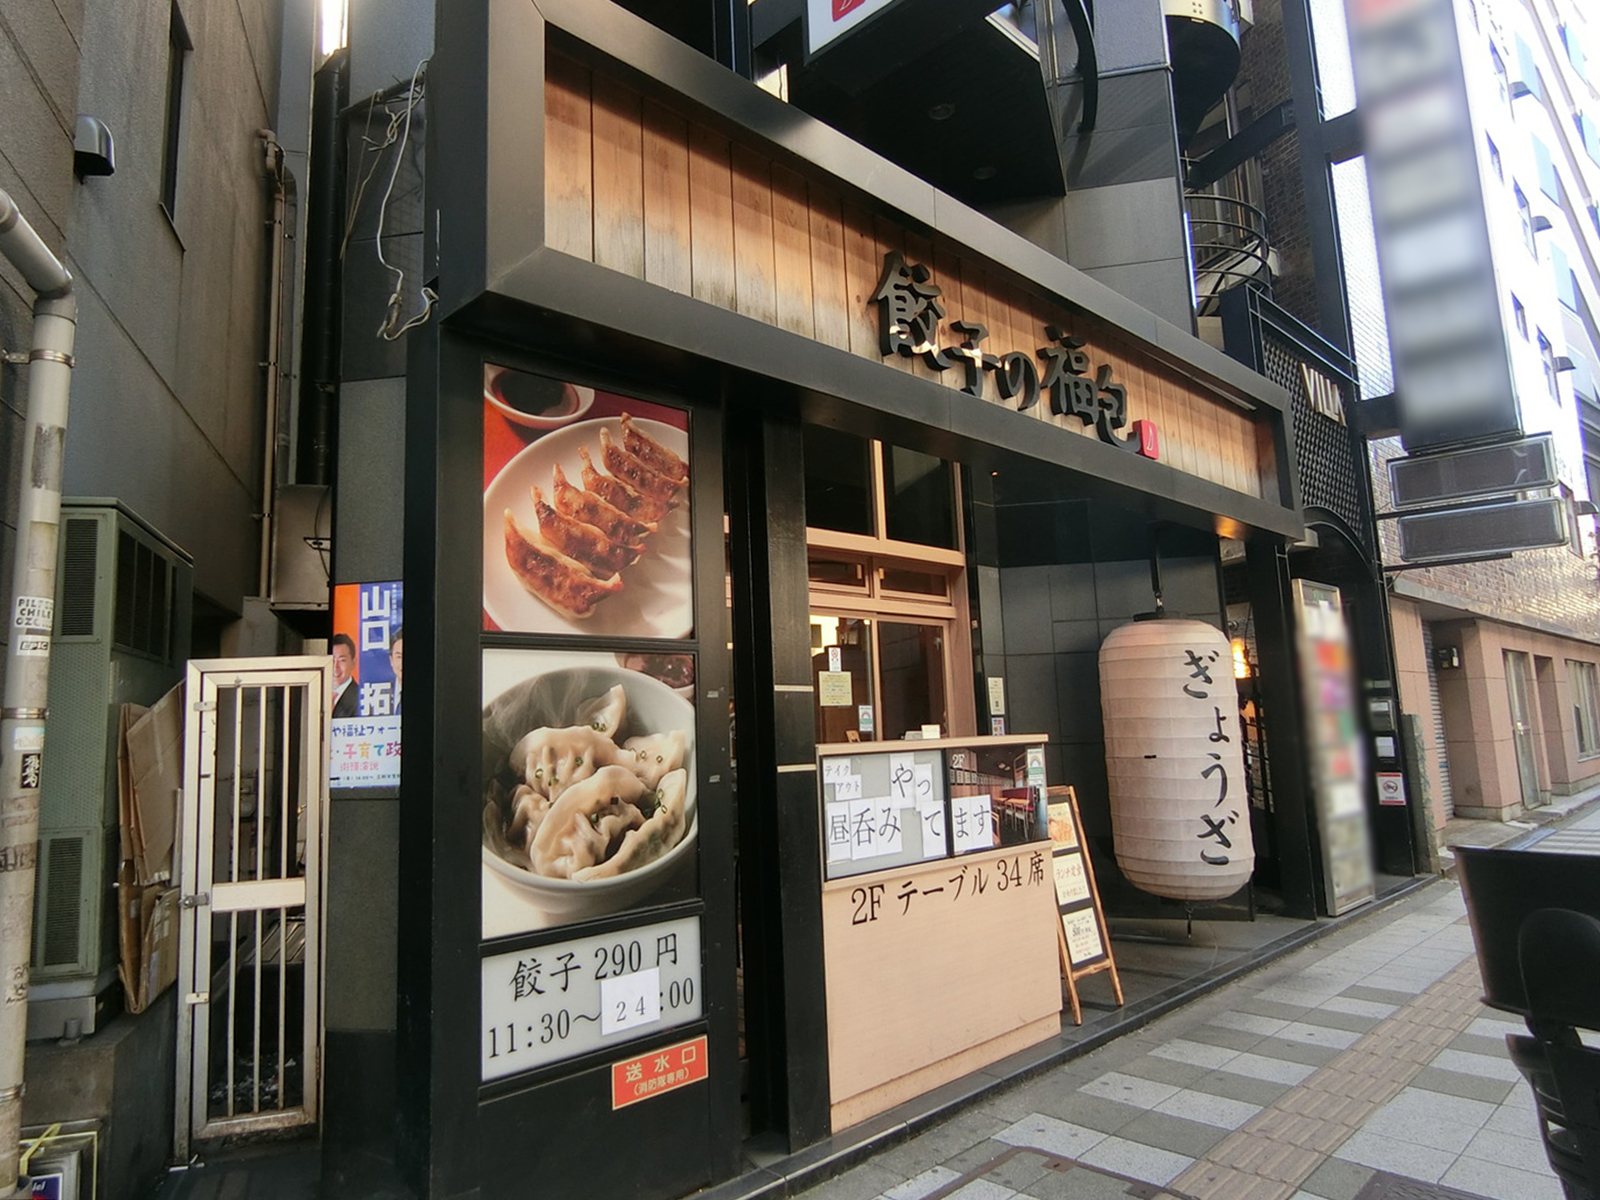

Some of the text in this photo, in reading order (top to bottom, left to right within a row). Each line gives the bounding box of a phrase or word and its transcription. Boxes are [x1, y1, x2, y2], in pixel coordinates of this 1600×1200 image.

[868, 248, 1142, 453] 餃子の福包
[1300, 362, 1347, 427] VILLA
[360, 585, 392, 717] 山口 拓
[332, 724, 401, 737] や福祉フォー
[952, 753, 965, 768] 2F
[1182, 649, 1240, 866] ぎょうざ
[829, 807, 901, 846] 昼呑み
[851, 850, 1045, 926] 2F テーブル 34 席
[508, 932, 678, 1002] 餃子 290 円
[625, 1046, 696, 1083] 送水口
